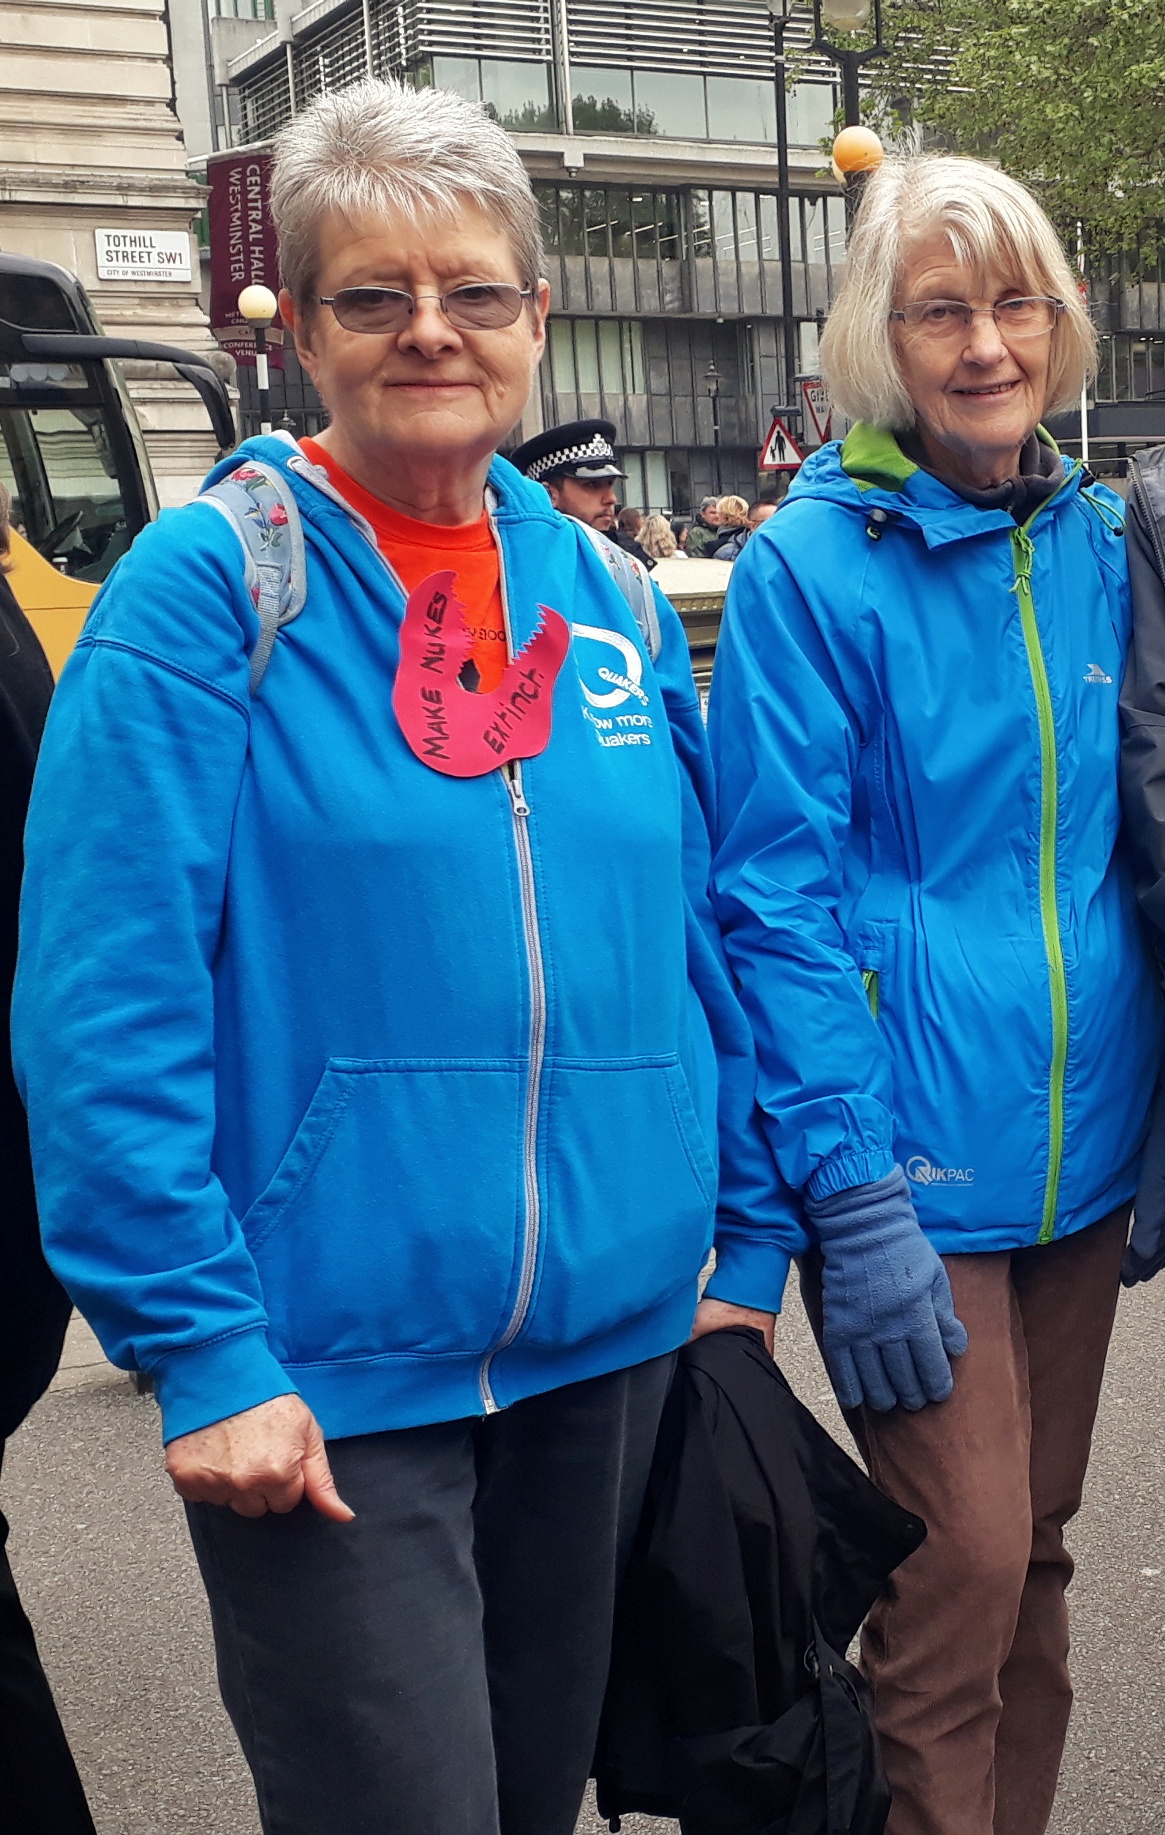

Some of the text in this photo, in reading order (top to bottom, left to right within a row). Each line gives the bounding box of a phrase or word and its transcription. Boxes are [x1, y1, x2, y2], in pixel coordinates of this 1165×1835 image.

[228, 167, 245, 282] WESTMINSTER
[246, 164, 263, 242] CENTRAL
[104, 234, 156, 248] TOTHILL
[105, 250, 183, 264] STREET SW1
[420, 591, 450, 759] MAKE NUKES
[597, 666, 650, 706] QUAKERS
